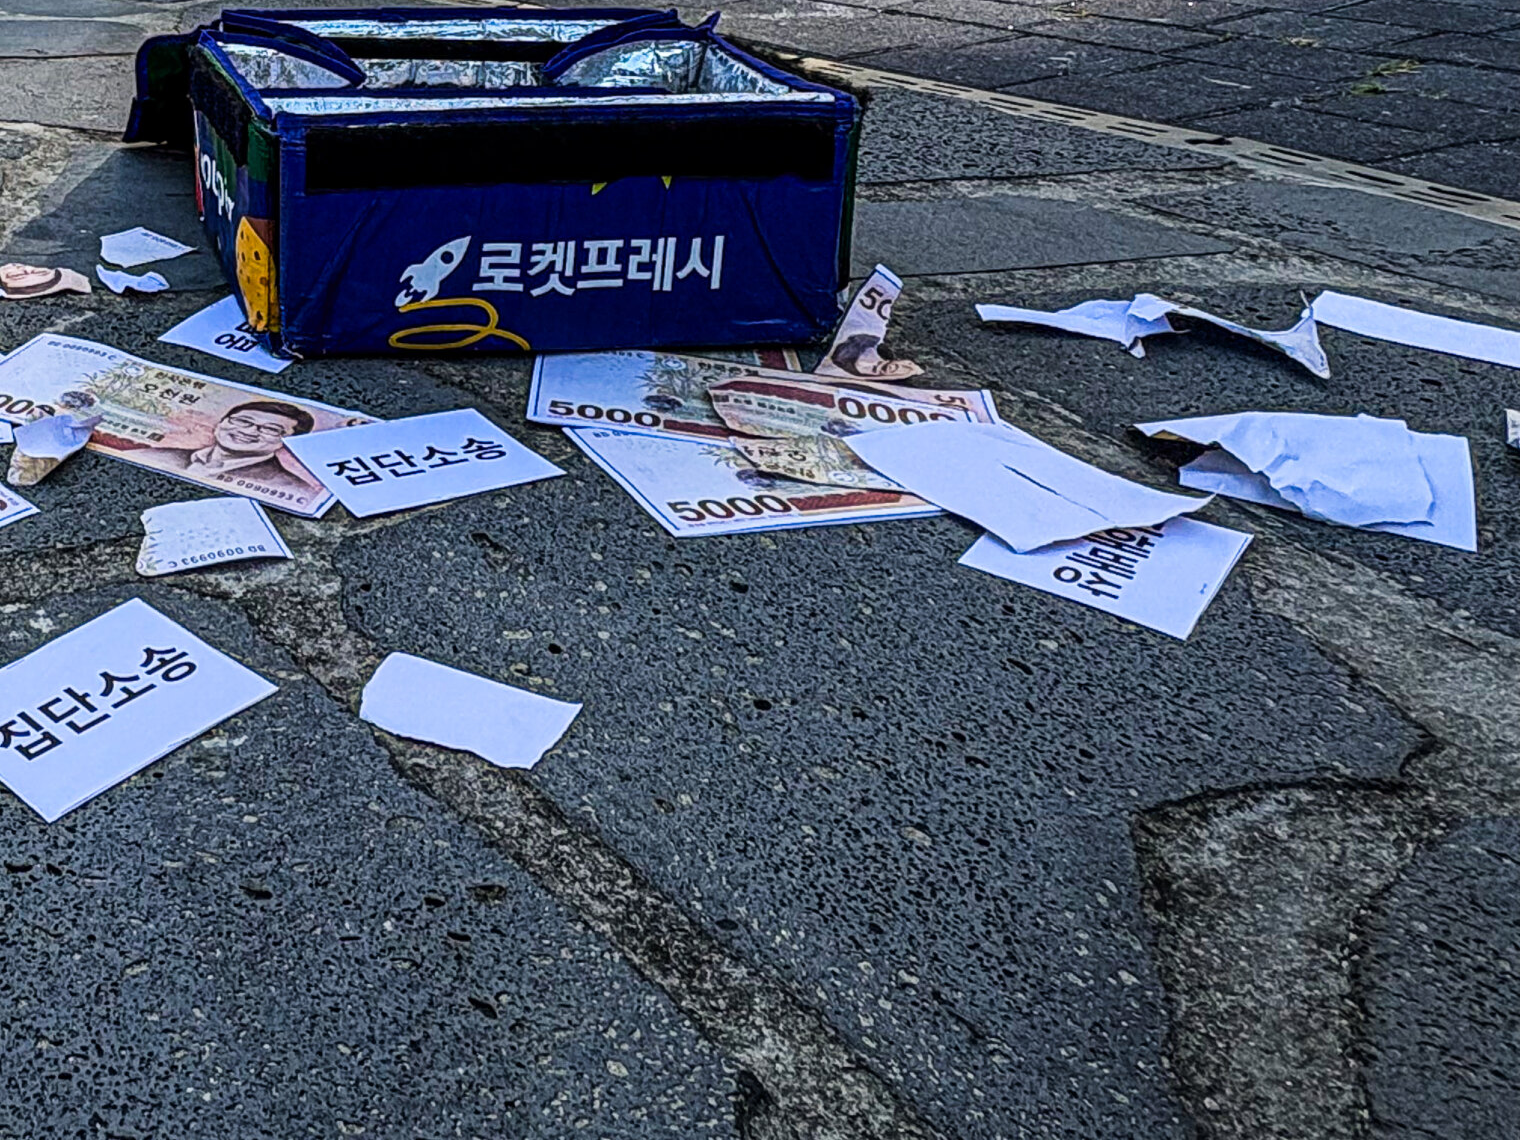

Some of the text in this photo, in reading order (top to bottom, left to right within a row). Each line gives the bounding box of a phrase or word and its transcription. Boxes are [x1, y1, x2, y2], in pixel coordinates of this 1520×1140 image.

[471, 234, 726, 298] 로켓프레시
[139, 384, 199, 404] 오천원
[548, 400, 661, 428] 5000
[332, 432, 509, 488] 집단소송
[667, 494, 793, 522] 5000
[1053, 526, 1165, 600] 해배상
